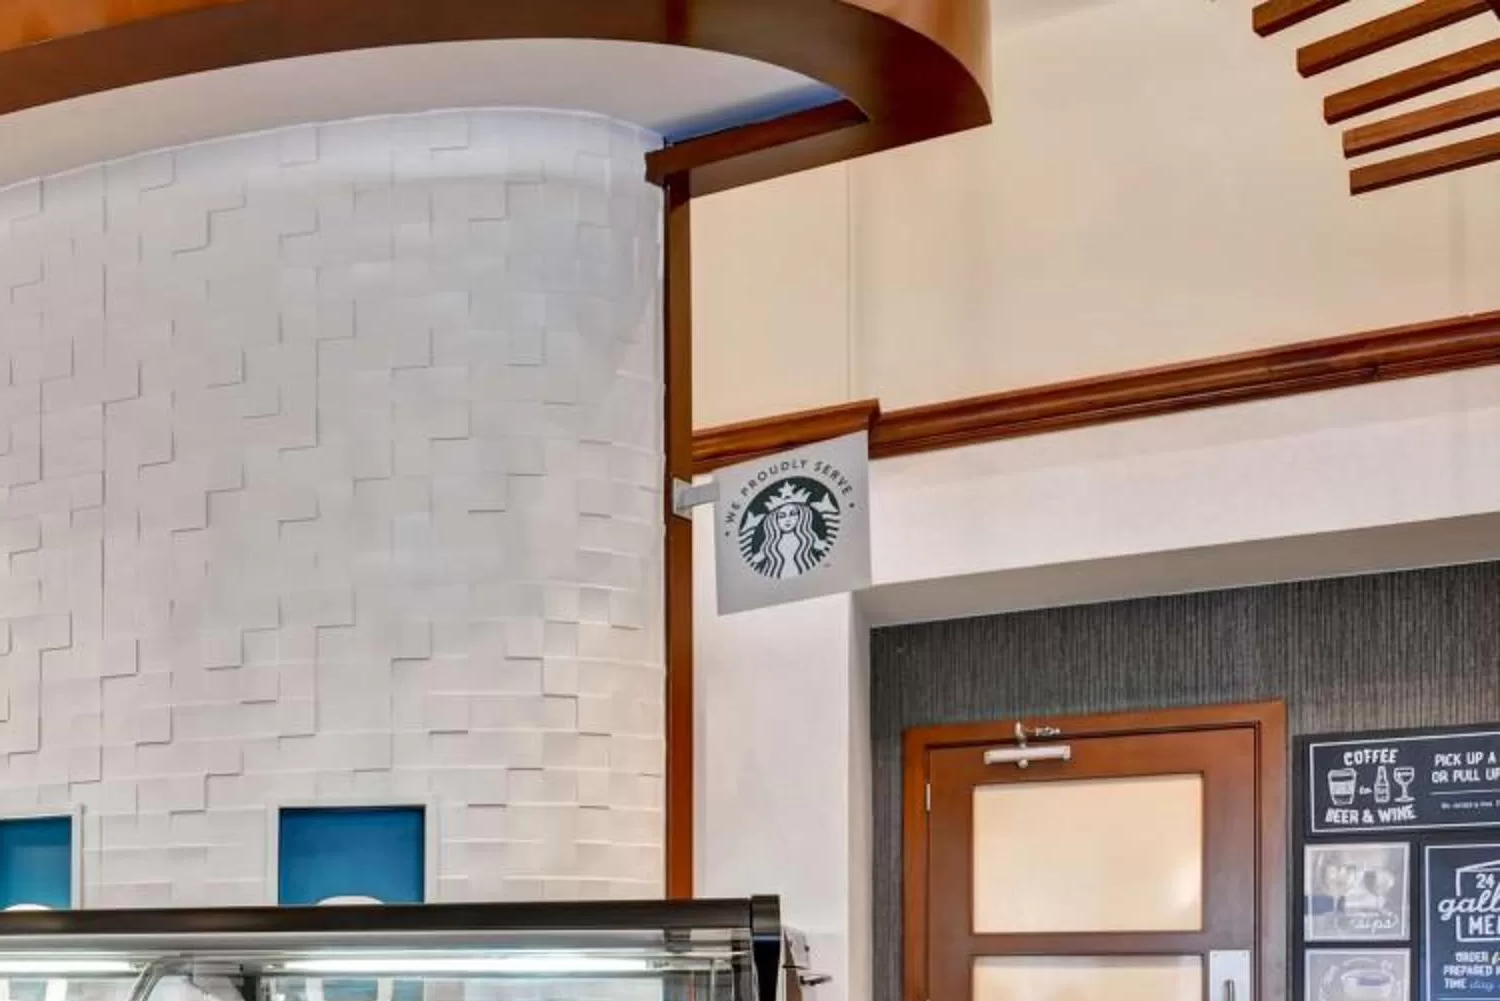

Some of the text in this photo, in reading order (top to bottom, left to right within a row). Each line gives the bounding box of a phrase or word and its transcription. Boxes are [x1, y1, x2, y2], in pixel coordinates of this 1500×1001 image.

[725, 459, 853, 525] WE PROUDLY SERVE
[1343, 748, 1399, 766] COFFEE
[1434, 751, 1497, 767] PICK UP A
[1431, 771, 1449, 783] OR
[1453, 769, 1481, 782] PULL
[1325, 804, 1417, 824] BEER & WINE
[1475, 873, 1495, 889] 24
[1468, 914, 1500, 936] ME
[1455, 951, 1489, 963] ORDER
[1443, 965, 1493, 977] PREPARED
[1444, 978, 1468, 989] TIME
